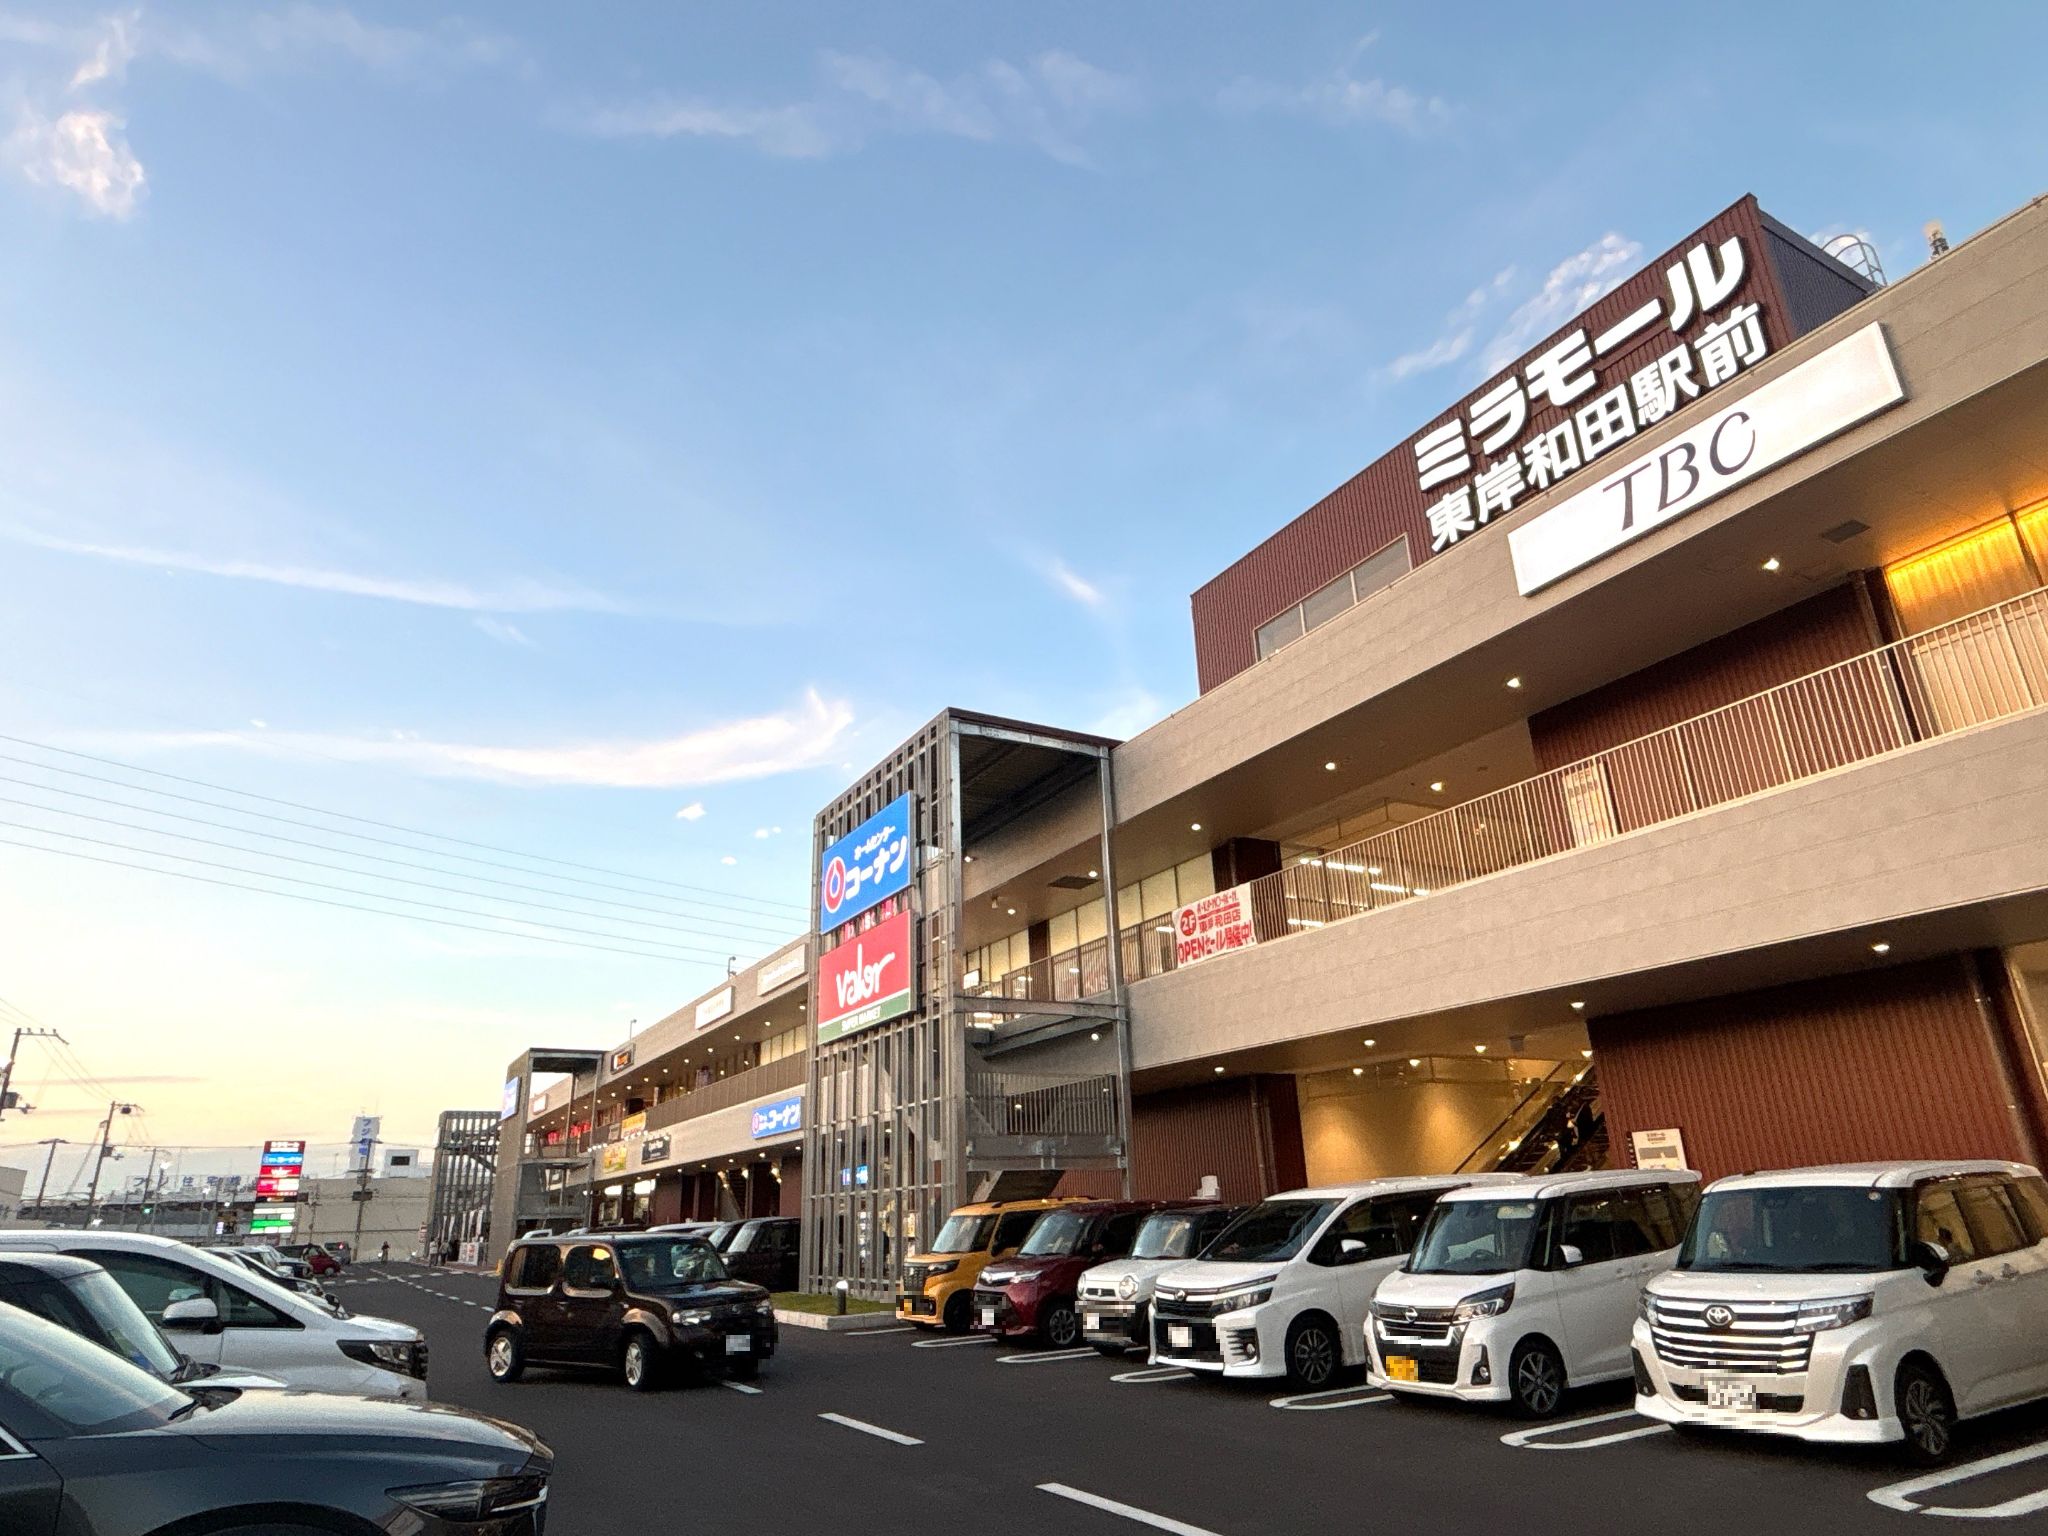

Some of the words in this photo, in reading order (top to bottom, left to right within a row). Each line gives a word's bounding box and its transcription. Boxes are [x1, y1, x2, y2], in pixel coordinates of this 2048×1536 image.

[1414, 236, 1746, 492] ミラモール
[1425, 302, 1769, 552] 東岸和田駅前
[1602, 411, 1756, 532] TBC
[845, 835, 908, 900] コーナン
